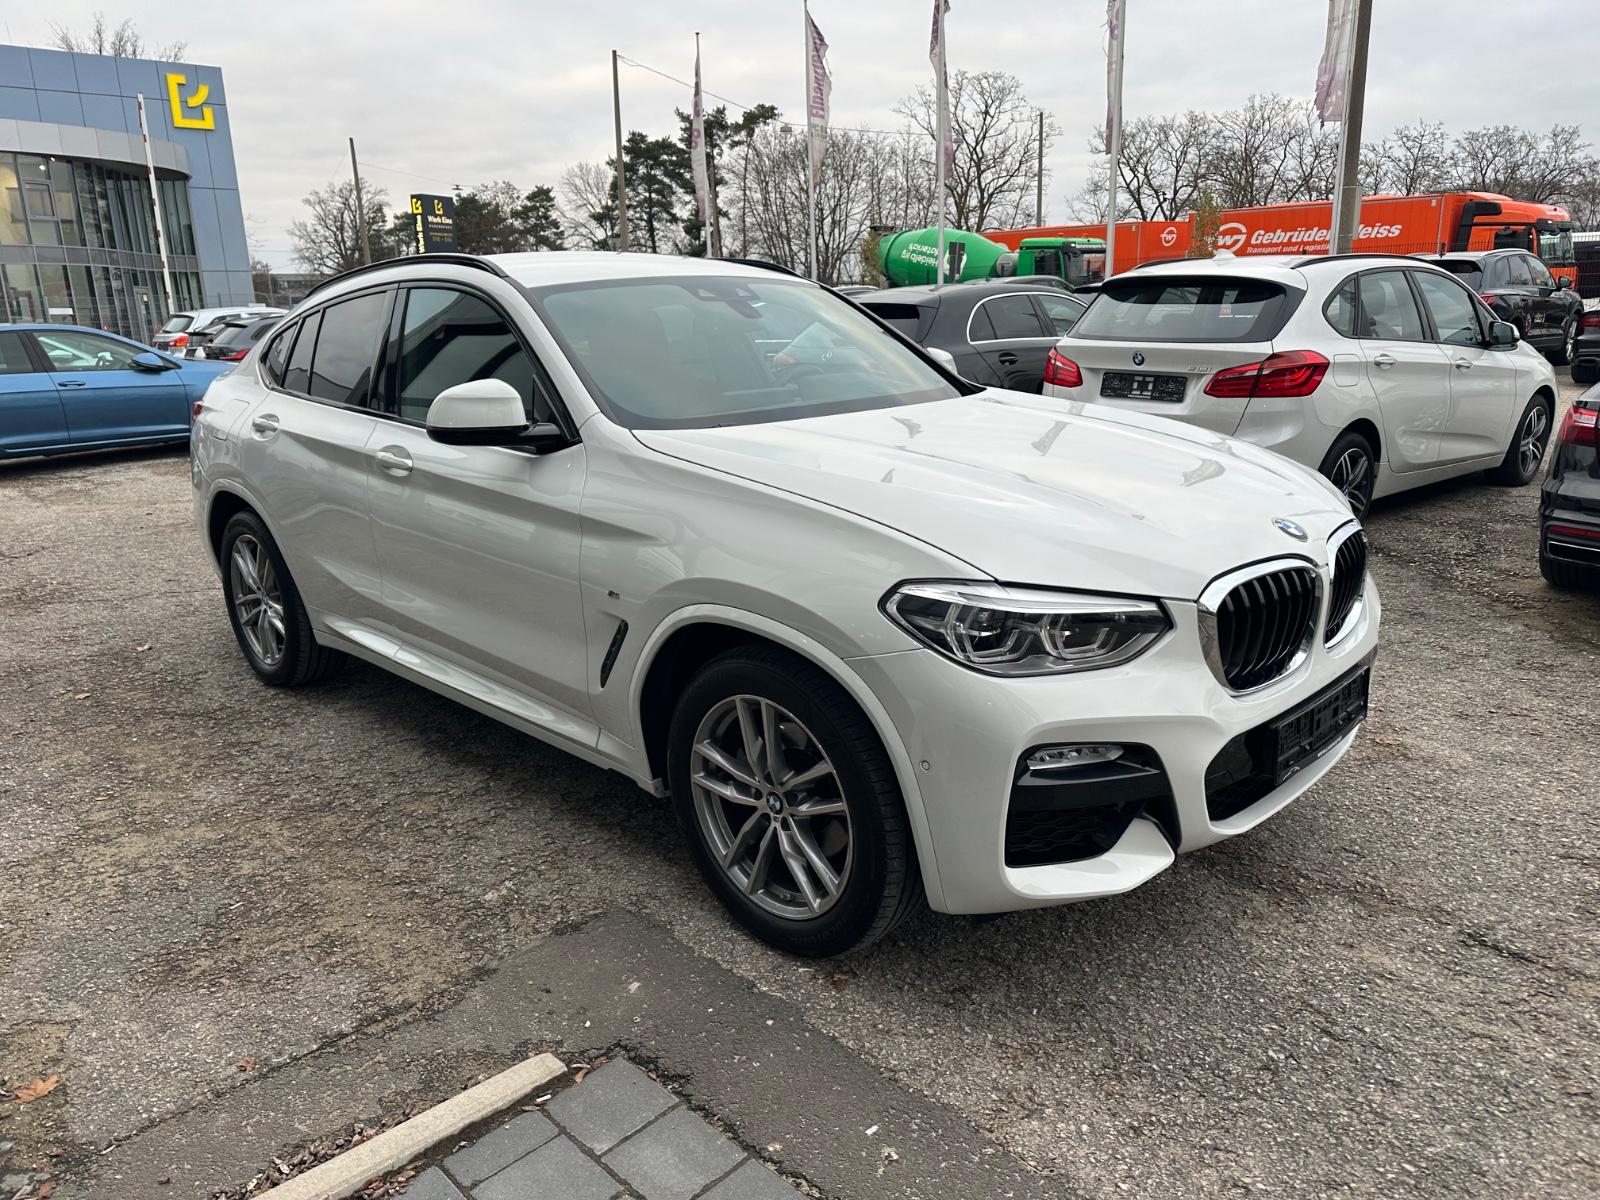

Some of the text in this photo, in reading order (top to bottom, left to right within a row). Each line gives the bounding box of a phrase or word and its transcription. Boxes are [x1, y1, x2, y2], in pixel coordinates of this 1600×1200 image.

[1357, 223, 1402, 239] eiss
[1247, 245, 1281, 254] Transport
[901, 249, 939, 267] Heidelbrg
